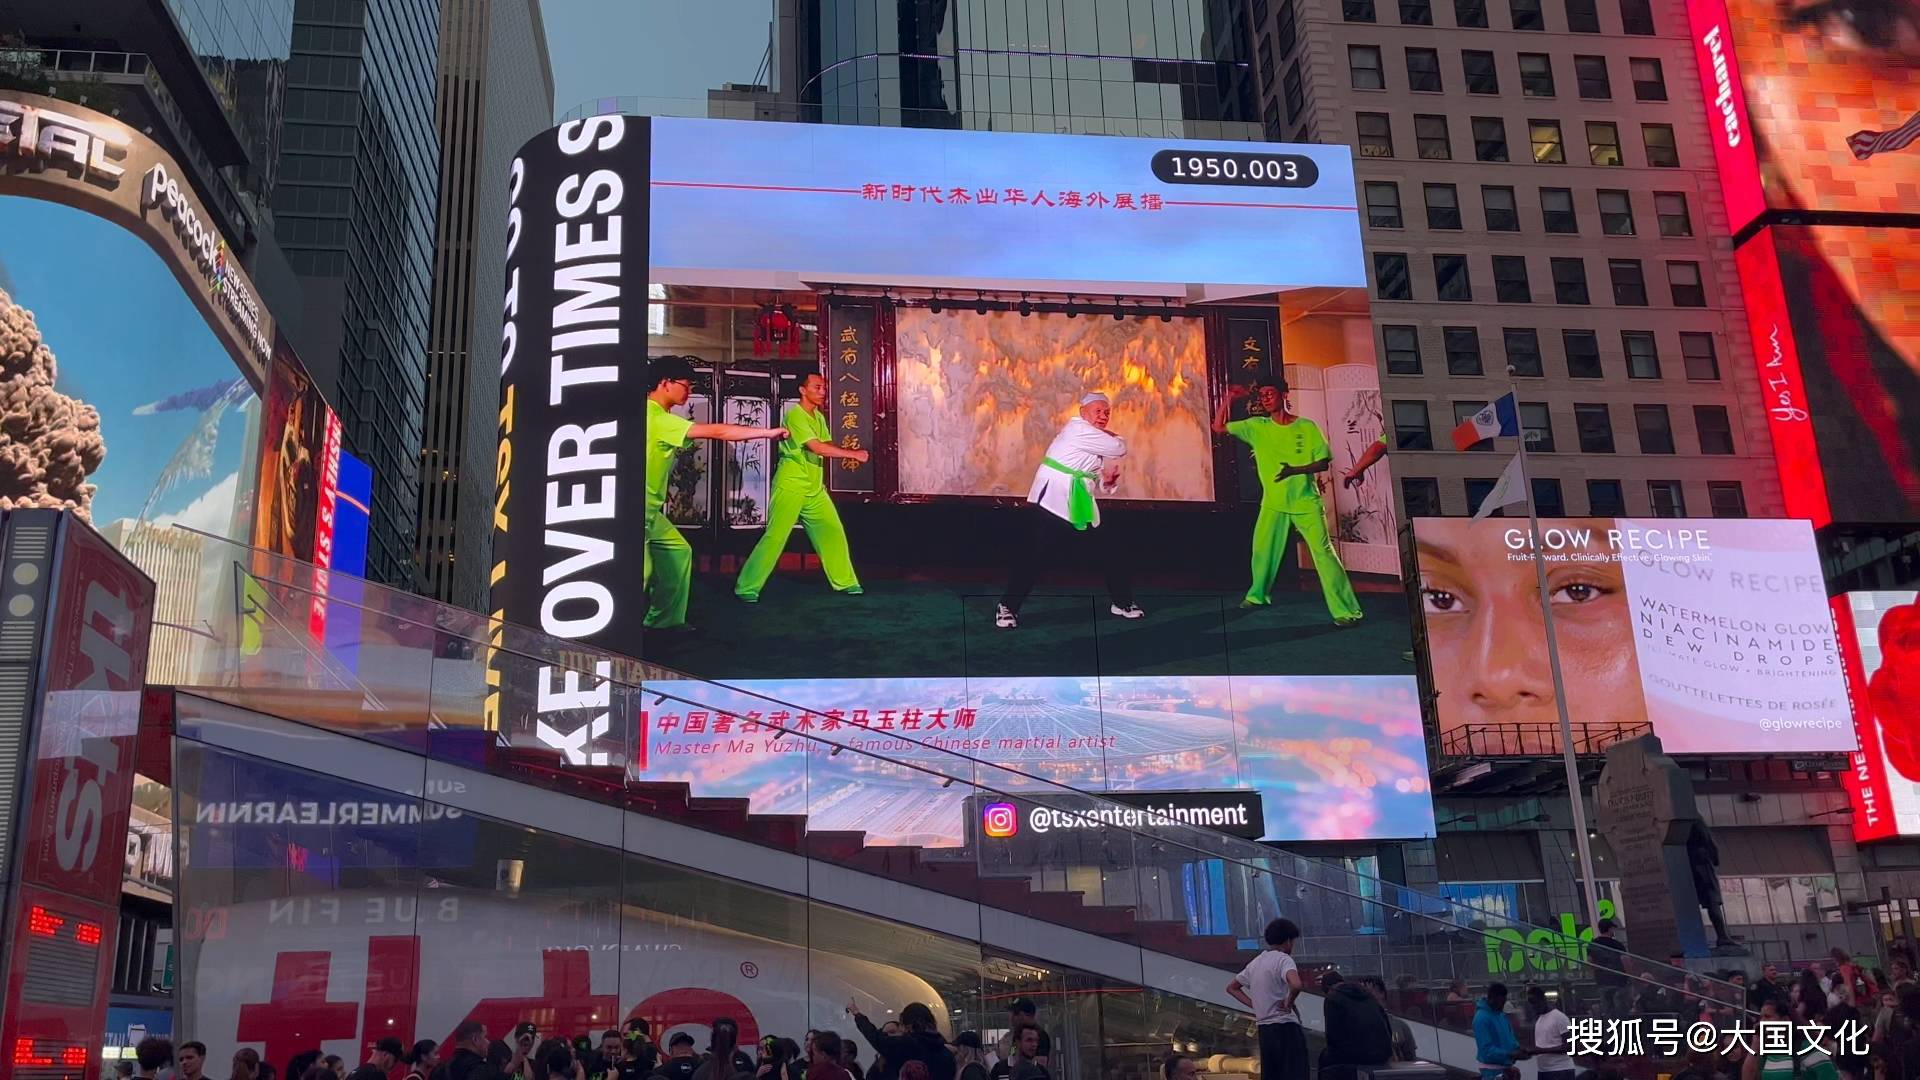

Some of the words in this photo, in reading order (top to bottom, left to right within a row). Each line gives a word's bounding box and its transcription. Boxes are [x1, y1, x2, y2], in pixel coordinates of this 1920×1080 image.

[1170, 155, 1300, 182] 1950.003
[860, 181, 1165, 212] 新时代杰出华人海外展播
[151, 162, 219, 274] peacock
[225, 258, 241, 291] NEW
[240, 282, 260, 323] SERIES
[549, 169, 624, 406] TIMES
[222, 276, 259, 338] STREAMING
[257, 331, 273, 361] NOW
[1770, 391, 1808, 422] Yes
[540, 420, 618, 638] OVER
[1504, 528, 1591, 550] GLOW
[1607, 528, 1711, 550] RECIPE
[1507, 552, 1569, 562] Fruit-Fward.
[1570, 552, 1610, 563] Clinically
[1654, 553, 1690, 564] Glowing
[1638, 549, 1715, 582] GLOW
[1729, 571, 1823, 594] RECIPE
[1640, 595, 1767, 633] WATERMELON
[1774, 622, 1830, 635] GLOW
[1640, 611, 1836, 651] NIACINAMIDE
[1643, 628, 1702, 653] DEW
[1733, 651, 1835, 666] DROPS
[1703, 659, 1740, 673] GLOW
[1756, 668, 1837, 678] BRIGHTENING
[1650, 673, 1763, 709] GOUTTELETTES
[1768, 700, 1788, 711] DE
[55, 579, 137, 873] tkts
[655, 708, 978, 735] 中国著名武术家马玉柱大师
[1759, 717, 1843, 734] @glowrecipe
[654, 740, 720, 755] Master
[727, 739, 754, 753] Ma
[848, 736, 913, 751] famous
[921, 736, 991, 750] Chinese
[998, 735, 1062, 749] martial
[1068, 734, 1117, 748] artist
[1029, 803, 1248, 833] @tsxentertainment
[1861, 787, 1879, 827] THE
